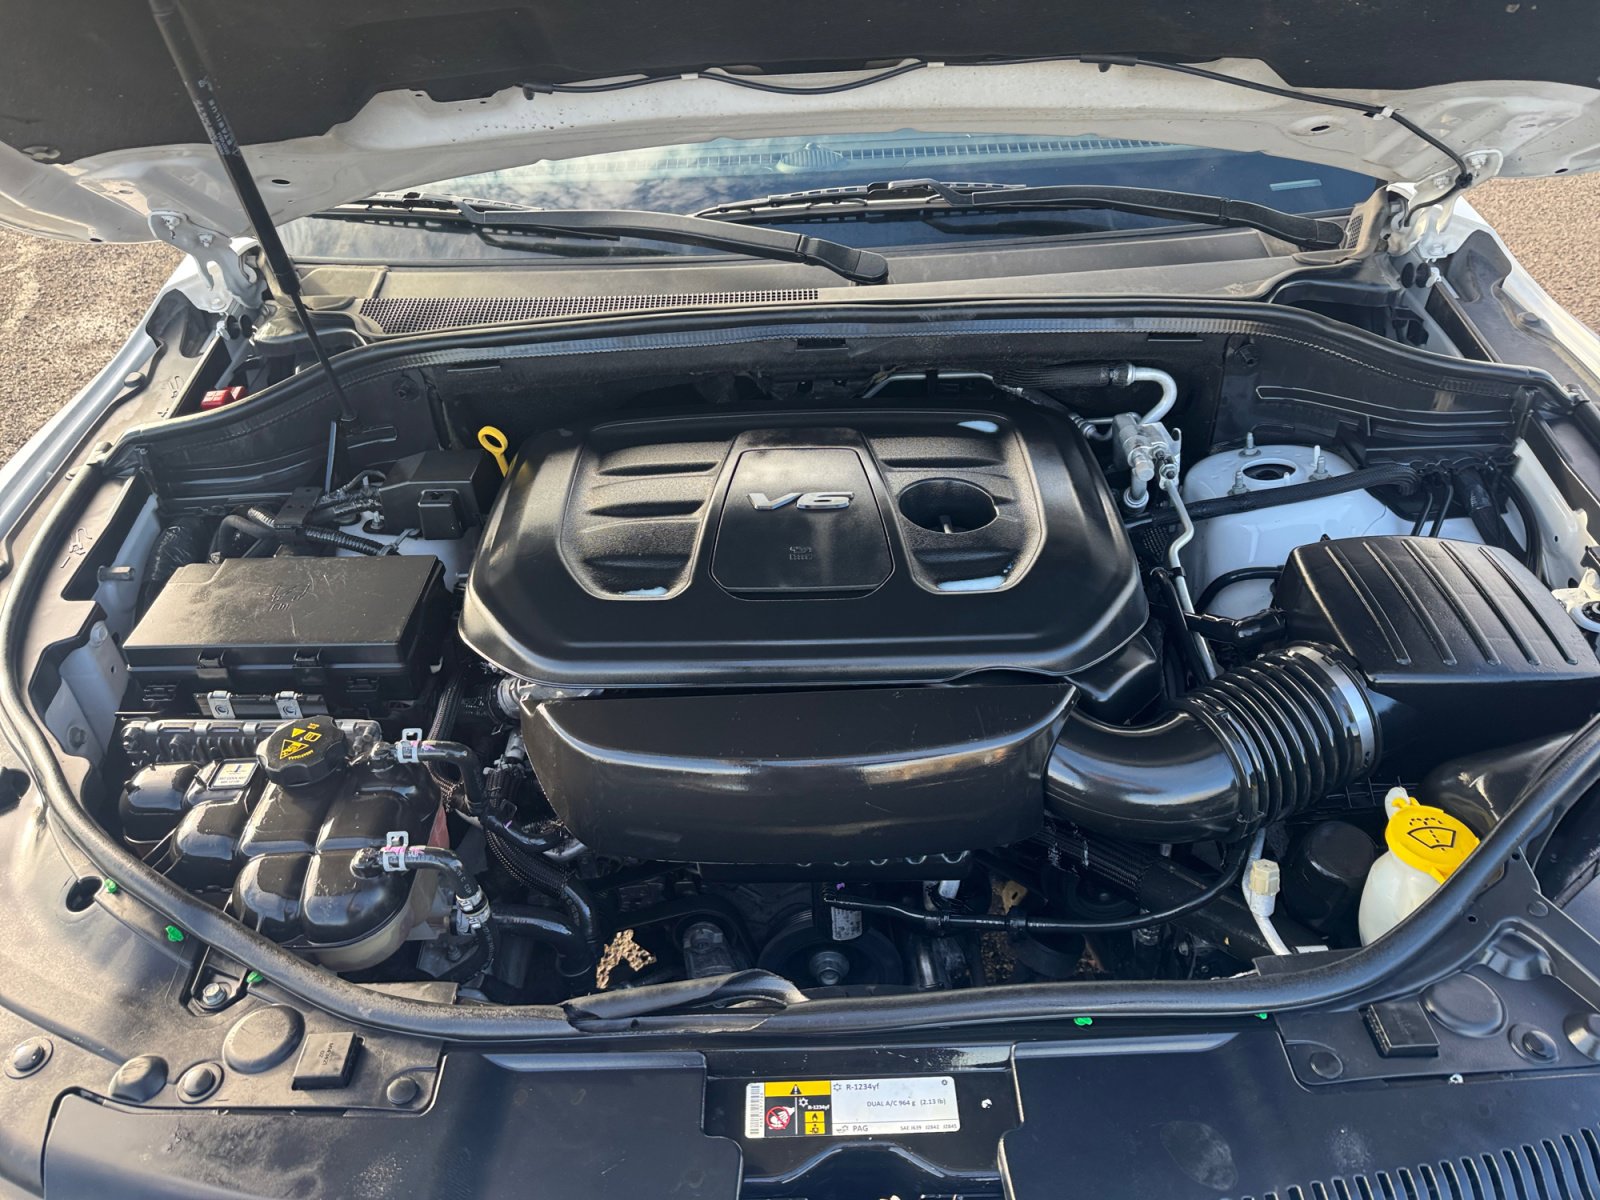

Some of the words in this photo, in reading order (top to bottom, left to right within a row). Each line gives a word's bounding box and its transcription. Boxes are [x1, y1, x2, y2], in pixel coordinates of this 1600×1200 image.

[747, 491, 855, 510] V6
[846, 1083, 880, 1092] R-1234yf
[885, 1100, 898, 1108] A/C
